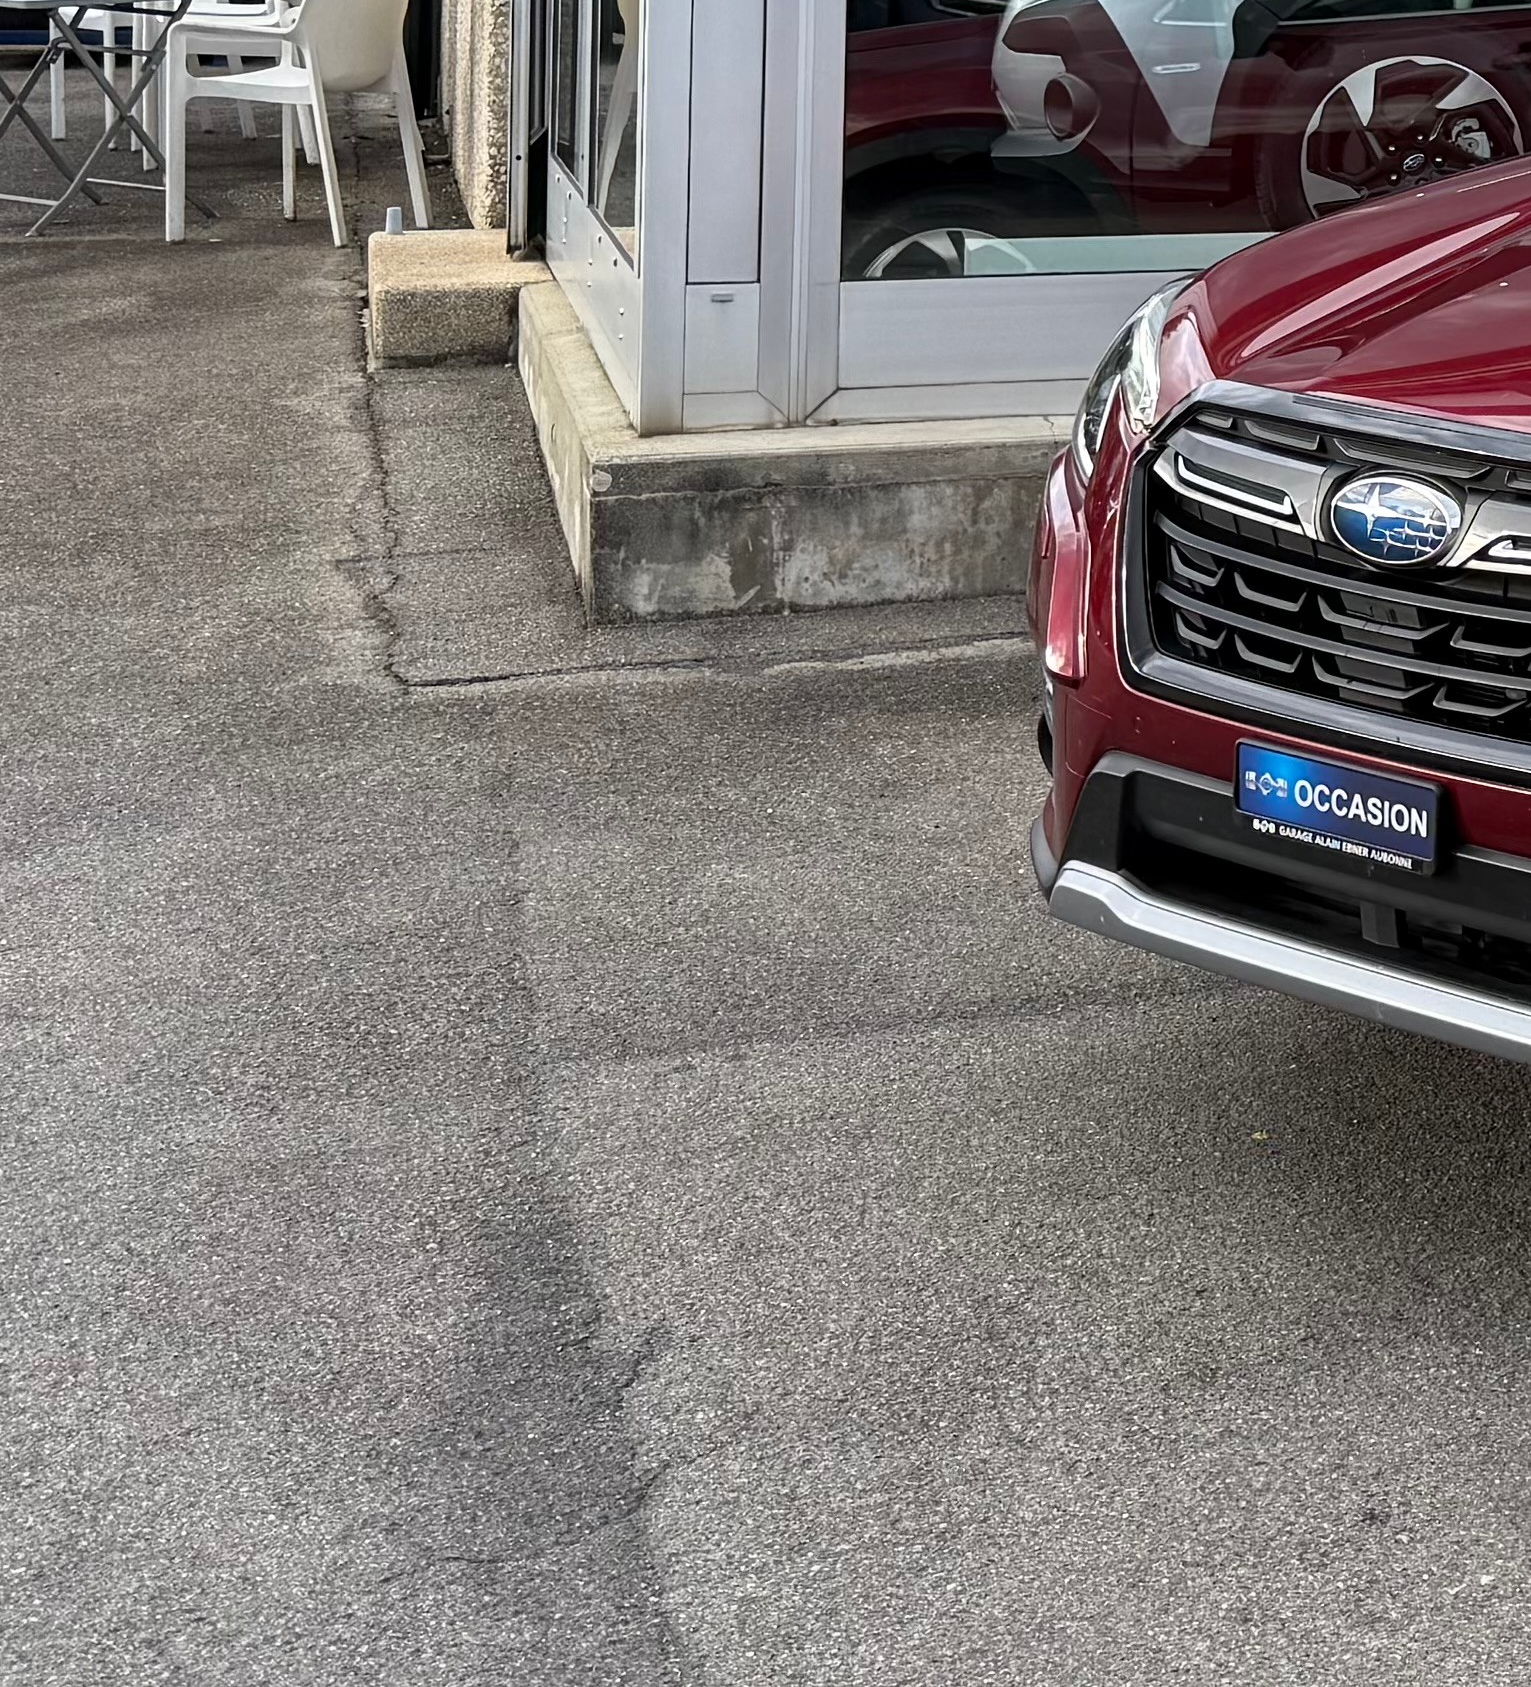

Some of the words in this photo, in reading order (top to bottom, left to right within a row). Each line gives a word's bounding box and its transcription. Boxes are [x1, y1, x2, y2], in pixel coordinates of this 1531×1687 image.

[1293, 779, 1428, 838] OCCASION
[1279, 825, 1313, 844] GARAGE
[1314, 836, 1341, 850] ALAIN
[1342, 842, 1369, 857] EBNER
